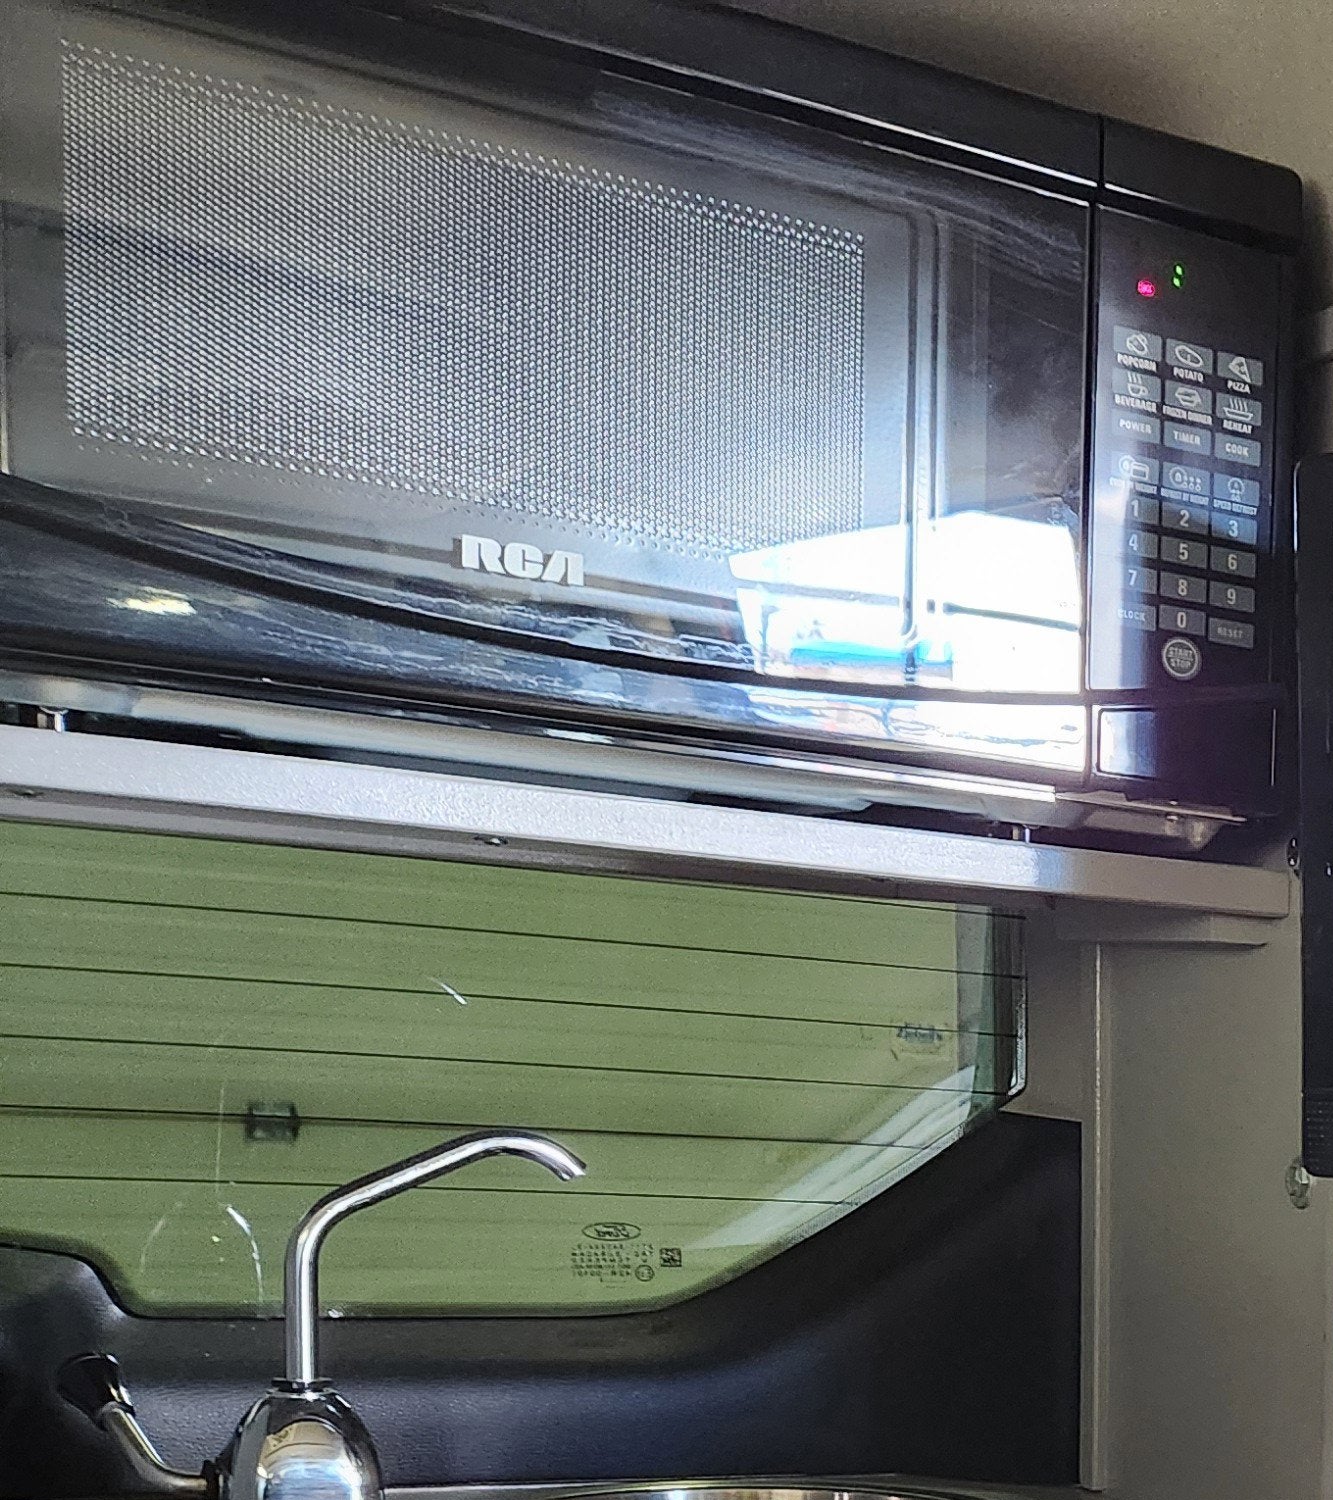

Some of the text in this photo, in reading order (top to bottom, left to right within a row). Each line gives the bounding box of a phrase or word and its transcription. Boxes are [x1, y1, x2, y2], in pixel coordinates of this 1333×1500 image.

[1117, 353, 1157, 372] POPCORN
[1173, 367, 1204, 382] POTATO
[1227, 380, 1250, 394] PIZZA
[1114, 394, 1157, 413] BEVERAGE
[1119, 419, 1152, 434] POWER
[1223, 419, 1252, 434] REHEAT
[1173, 431, 1201, 445] TIMER
[1225, 442, 1249, 456] COOK
[1131, 499, 1139, 518] 1
[1179, 509, 1190, 527] 2
[1228, 520, 1238, 537] 3
[1128, 533, 1138, 551] 4
[1179, 542, 1189, 560] 5
[462, 534, 585, 587] RCA
[1227, 553, 1237, 570] 6
[1128, 569, 1137, 587] 7
[1178, 579, 1188, 596] 8
[1227, 588, 1236, 604] 9
[1117, 608, 1146, 622] CLOCK
[1176, 611, 1187, 629] 0
[1167, 646, 1193, 661] START
[1170, 657, 1191, 669] STOP
